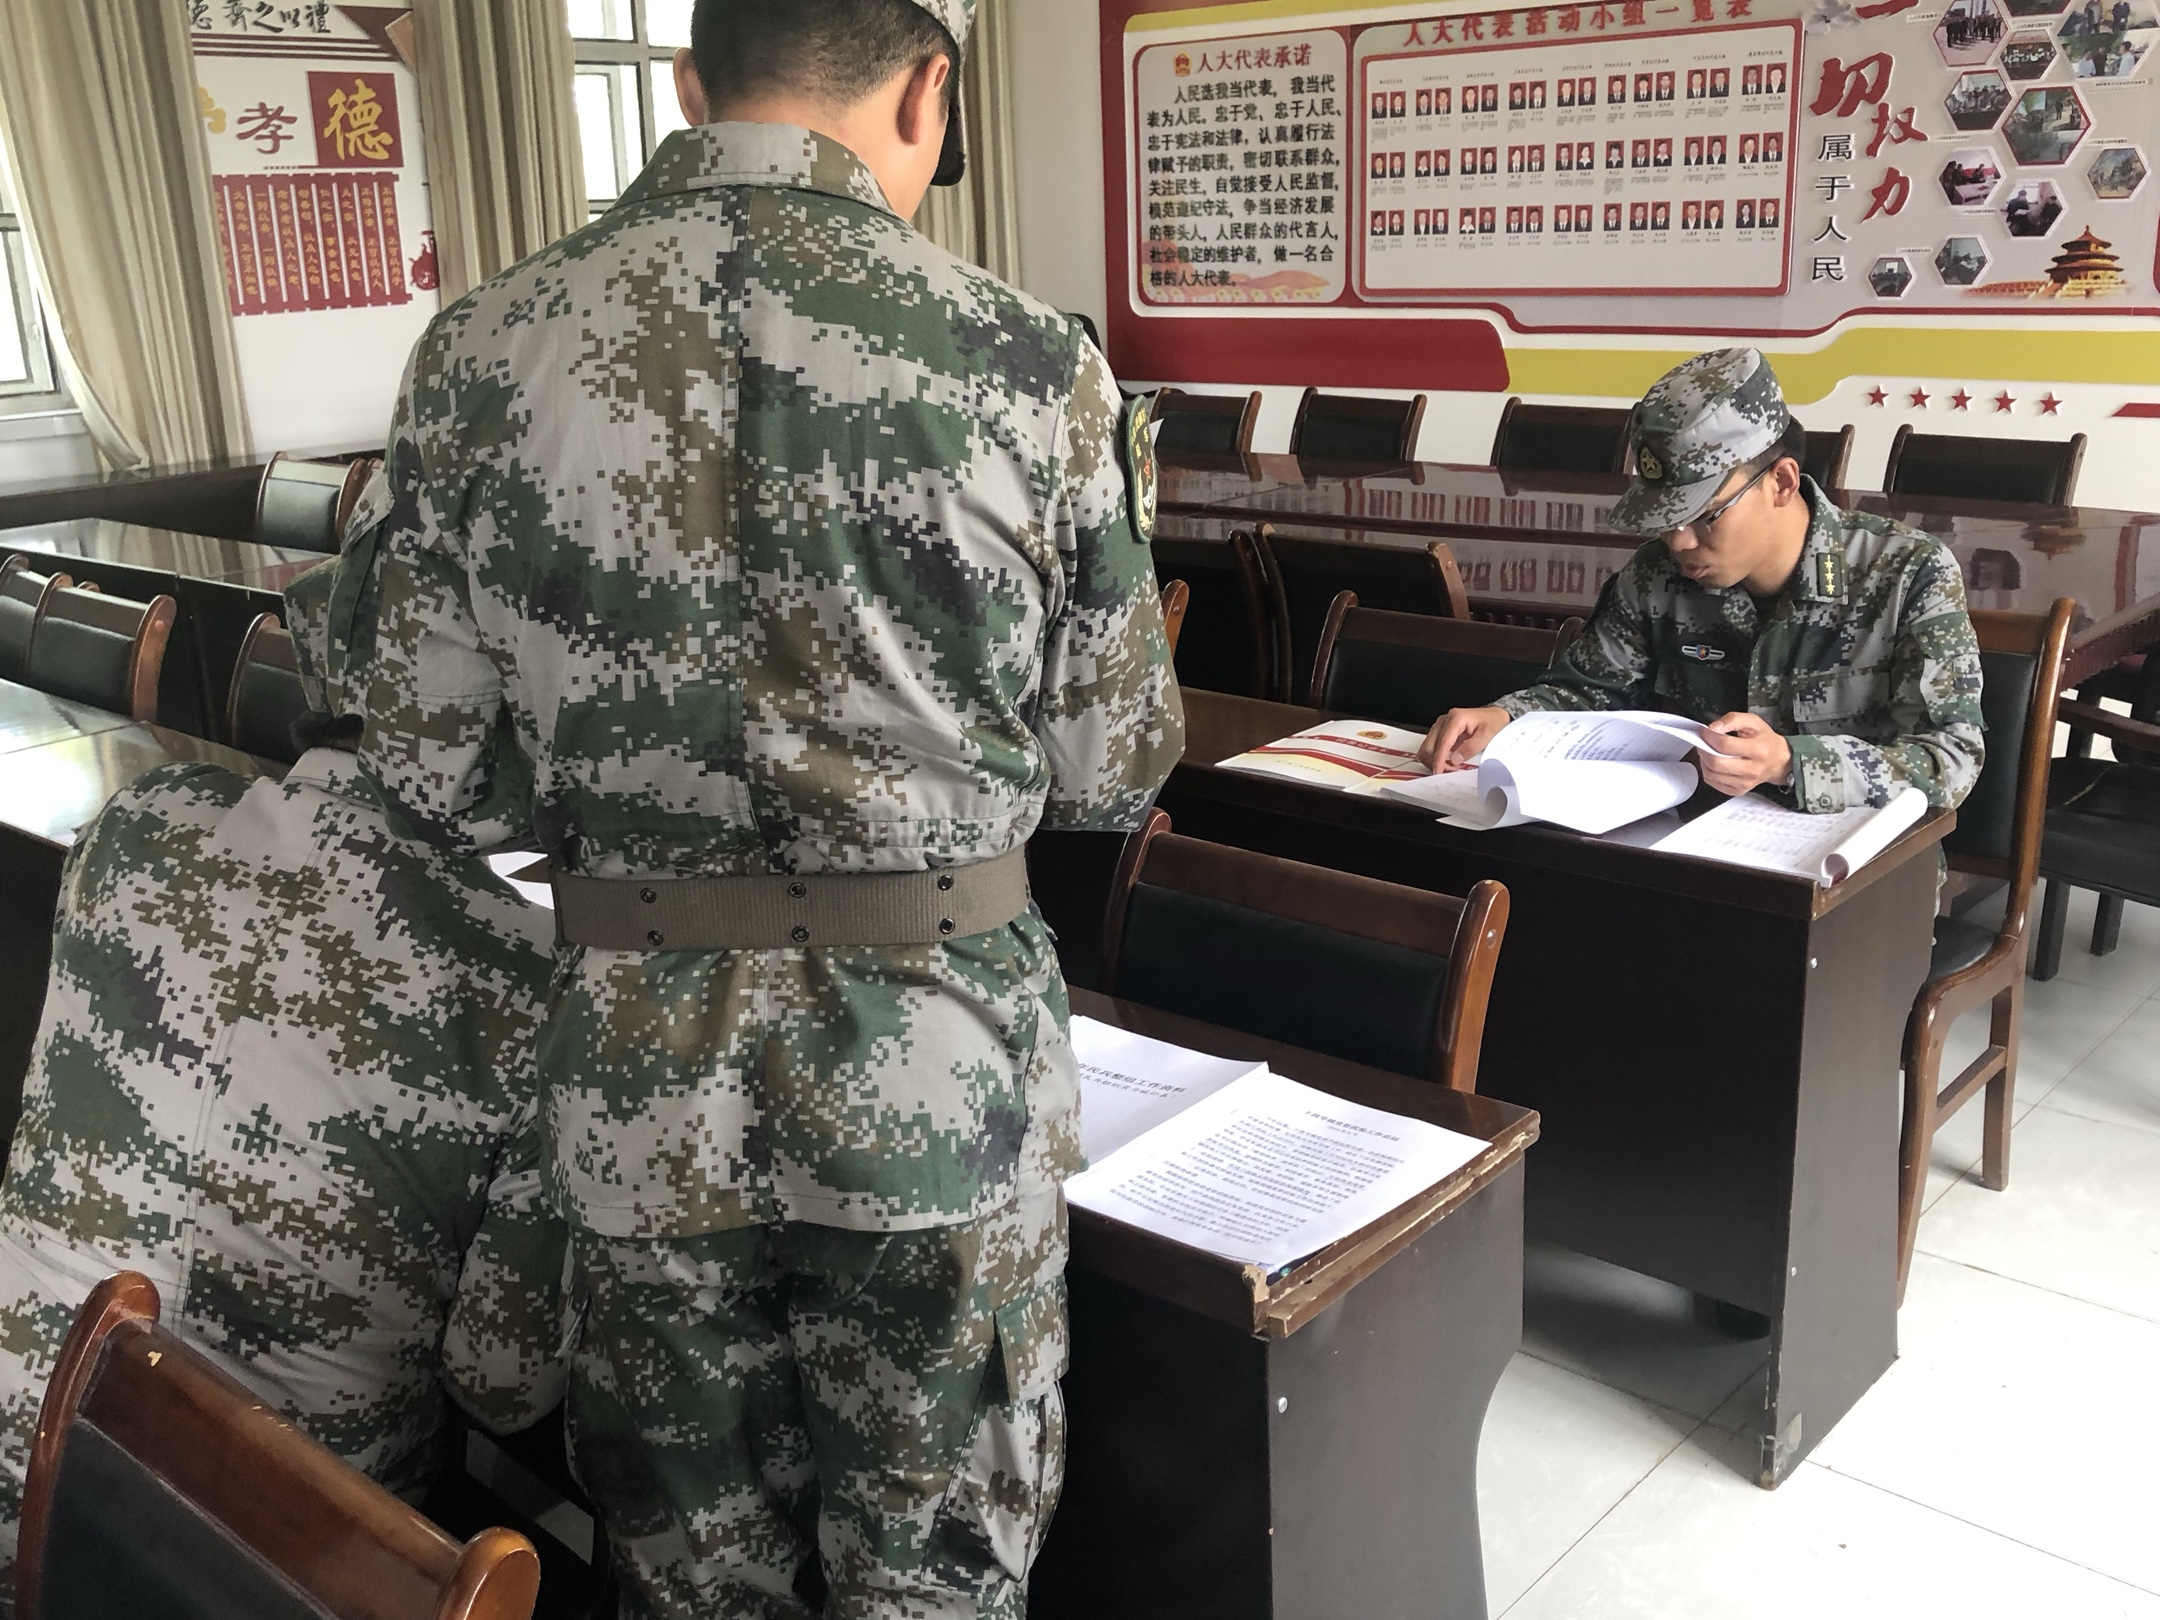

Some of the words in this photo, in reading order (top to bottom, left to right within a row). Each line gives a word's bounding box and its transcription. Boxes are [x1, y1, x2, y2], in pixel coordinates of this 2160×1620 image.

[1403, 0, 1752, 47] 人大代表活动小组一览表
[1197, 44, 1312, 73] 人大代表承诺
[236, 102, 297, 155] 孝
[324, 79, 394, 160] 德
[1810, 134, 1853, 282] 属于人民
